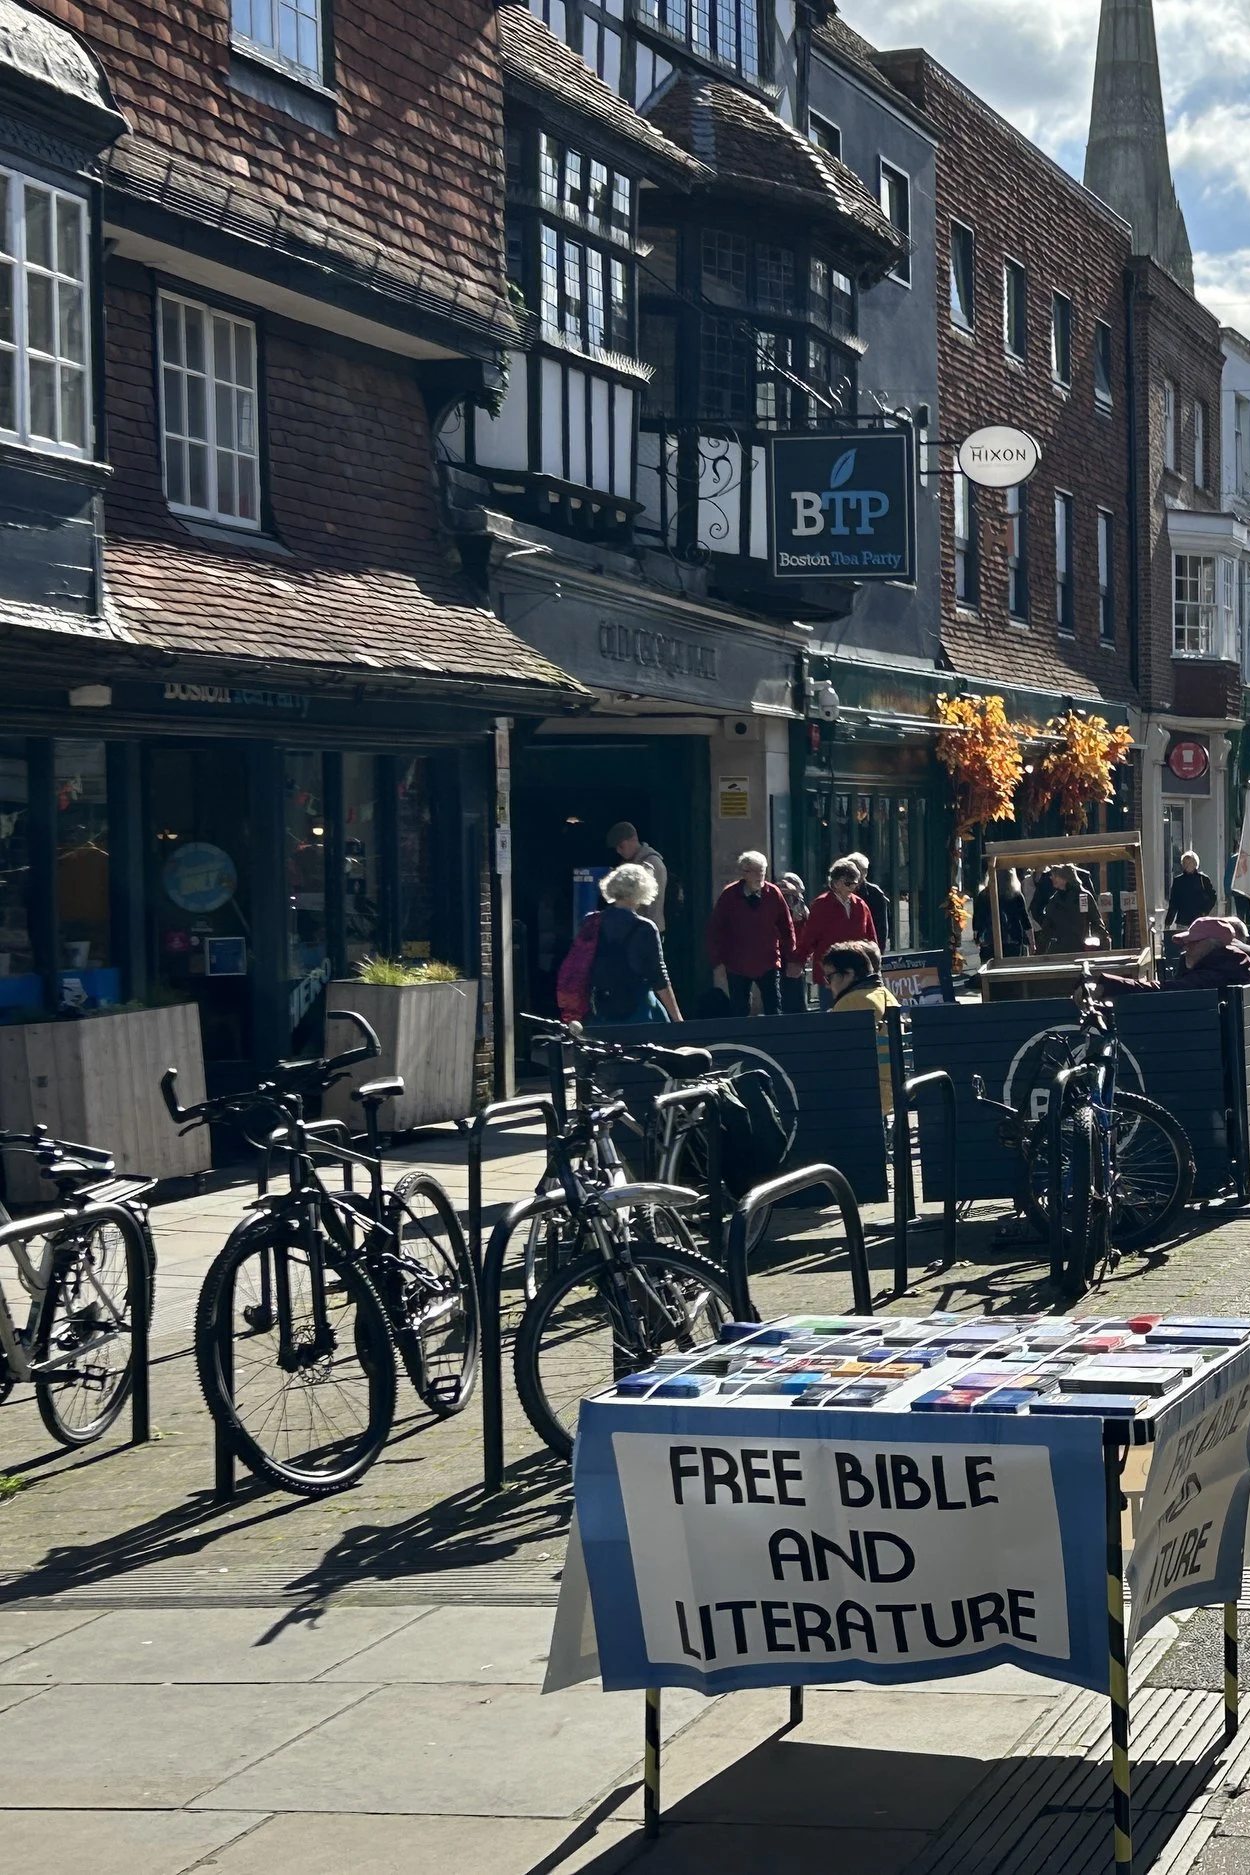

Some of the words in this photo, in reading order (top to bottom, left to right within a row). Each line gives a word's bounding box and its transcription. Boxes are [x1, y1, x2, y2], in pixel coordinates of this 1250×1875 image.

[969, 445, 1026, 462] HIXON
[790, 490, 890, 536] BTP
[779, 552, 831, 567] Boston
[831, 551, 860, 566] Tea
[862, 551, 902, 569] Party
[669, 1445, 806, 1506] FREE
[834, 1451, 999, 1510] BIBLE
[768, 1527, 915, 1583] AND
[674, 1588, 1038, 1661] LITERATURE
